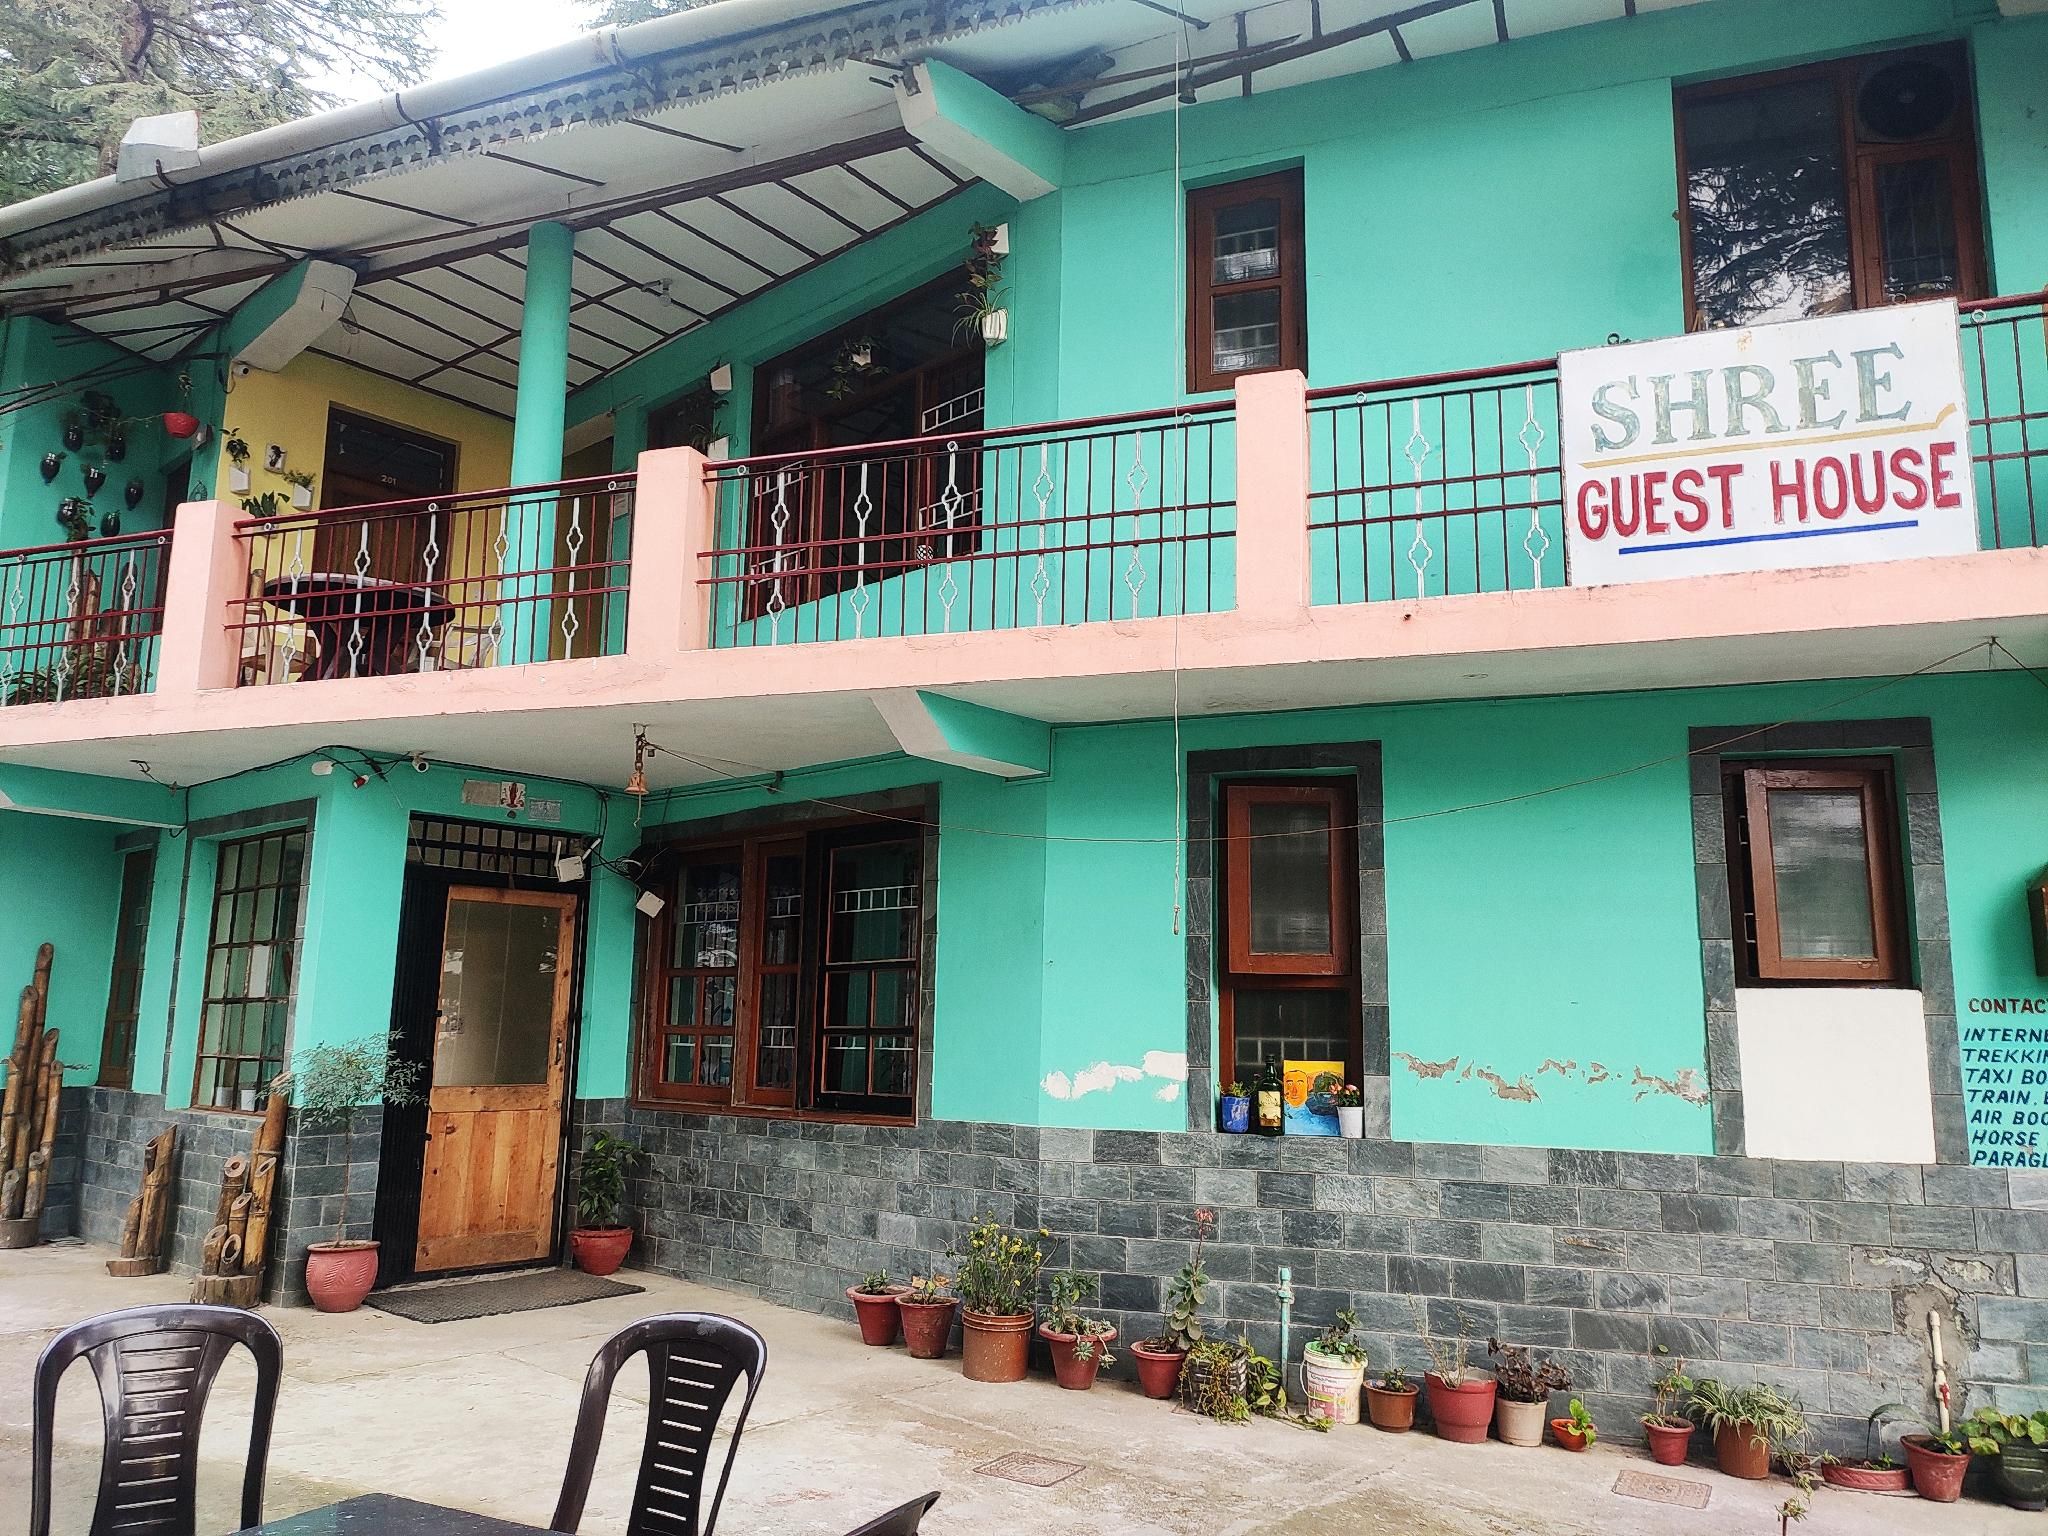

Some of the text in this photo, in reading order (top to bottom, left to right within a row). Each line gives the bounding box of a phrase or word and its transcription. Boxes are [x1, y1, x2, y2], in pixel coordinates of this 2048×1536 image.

[1591, 341, 1913, 453] SHREE
[381, 474, 397, 485] 201
[1577, 442, 1962, 542] GUEST HOUSE
[1968, 998, 2048, 1014] CONTAC
[1965, 1068, 2013, 1084] TAXI
[1970, 1109, 2002, 1125] AIR
[1972, 1129, 2040, 1147] HORSE
